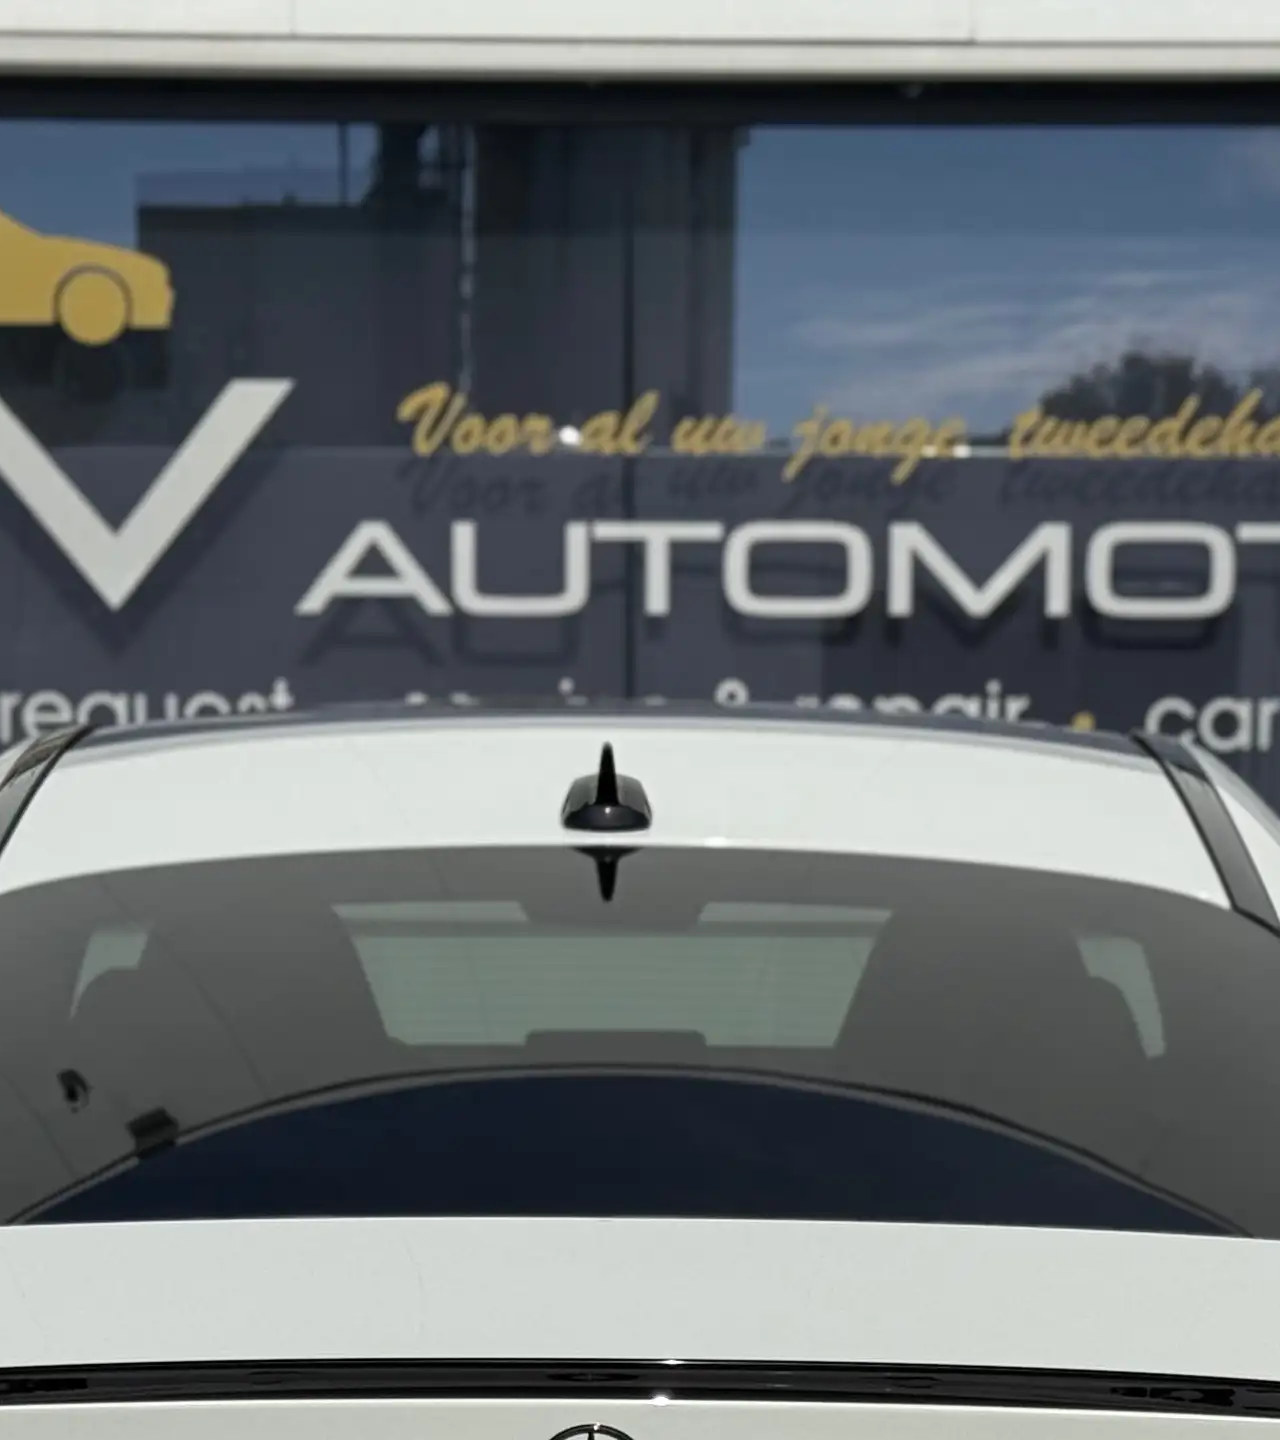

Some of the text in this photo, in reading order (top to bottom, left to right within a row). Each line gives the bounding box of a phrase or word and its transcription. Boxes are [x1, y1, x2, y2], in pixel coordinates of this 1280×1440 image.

[398, 382, 554, 456] Voor
[578, 391, 660, 456] al
[671, 415, 766, 456] uw
[781, 405, 967, 485] jonge
